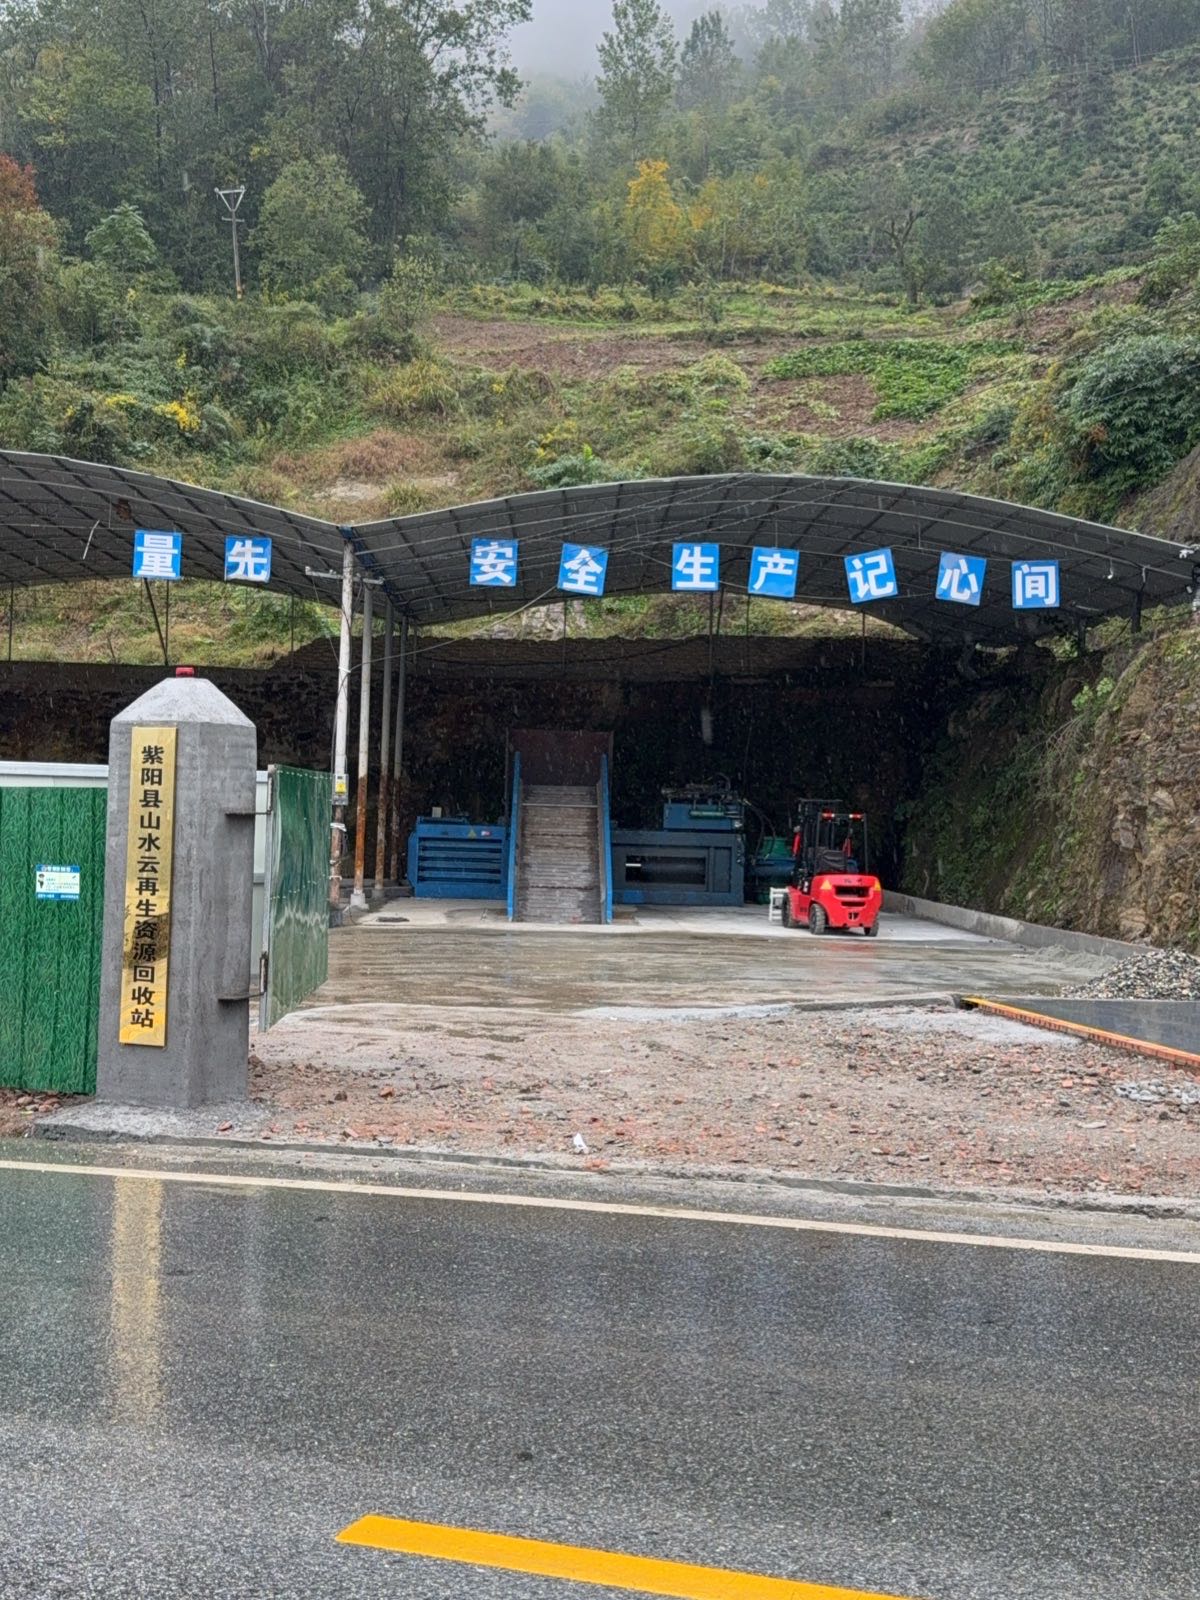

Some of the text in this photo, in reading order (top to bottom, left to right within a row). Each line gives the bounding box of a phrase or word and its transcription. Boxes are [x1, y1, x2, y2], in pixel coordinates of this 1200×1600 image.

[130, 744, 165, 1029] 紫阳县山水云再生资源回收站
